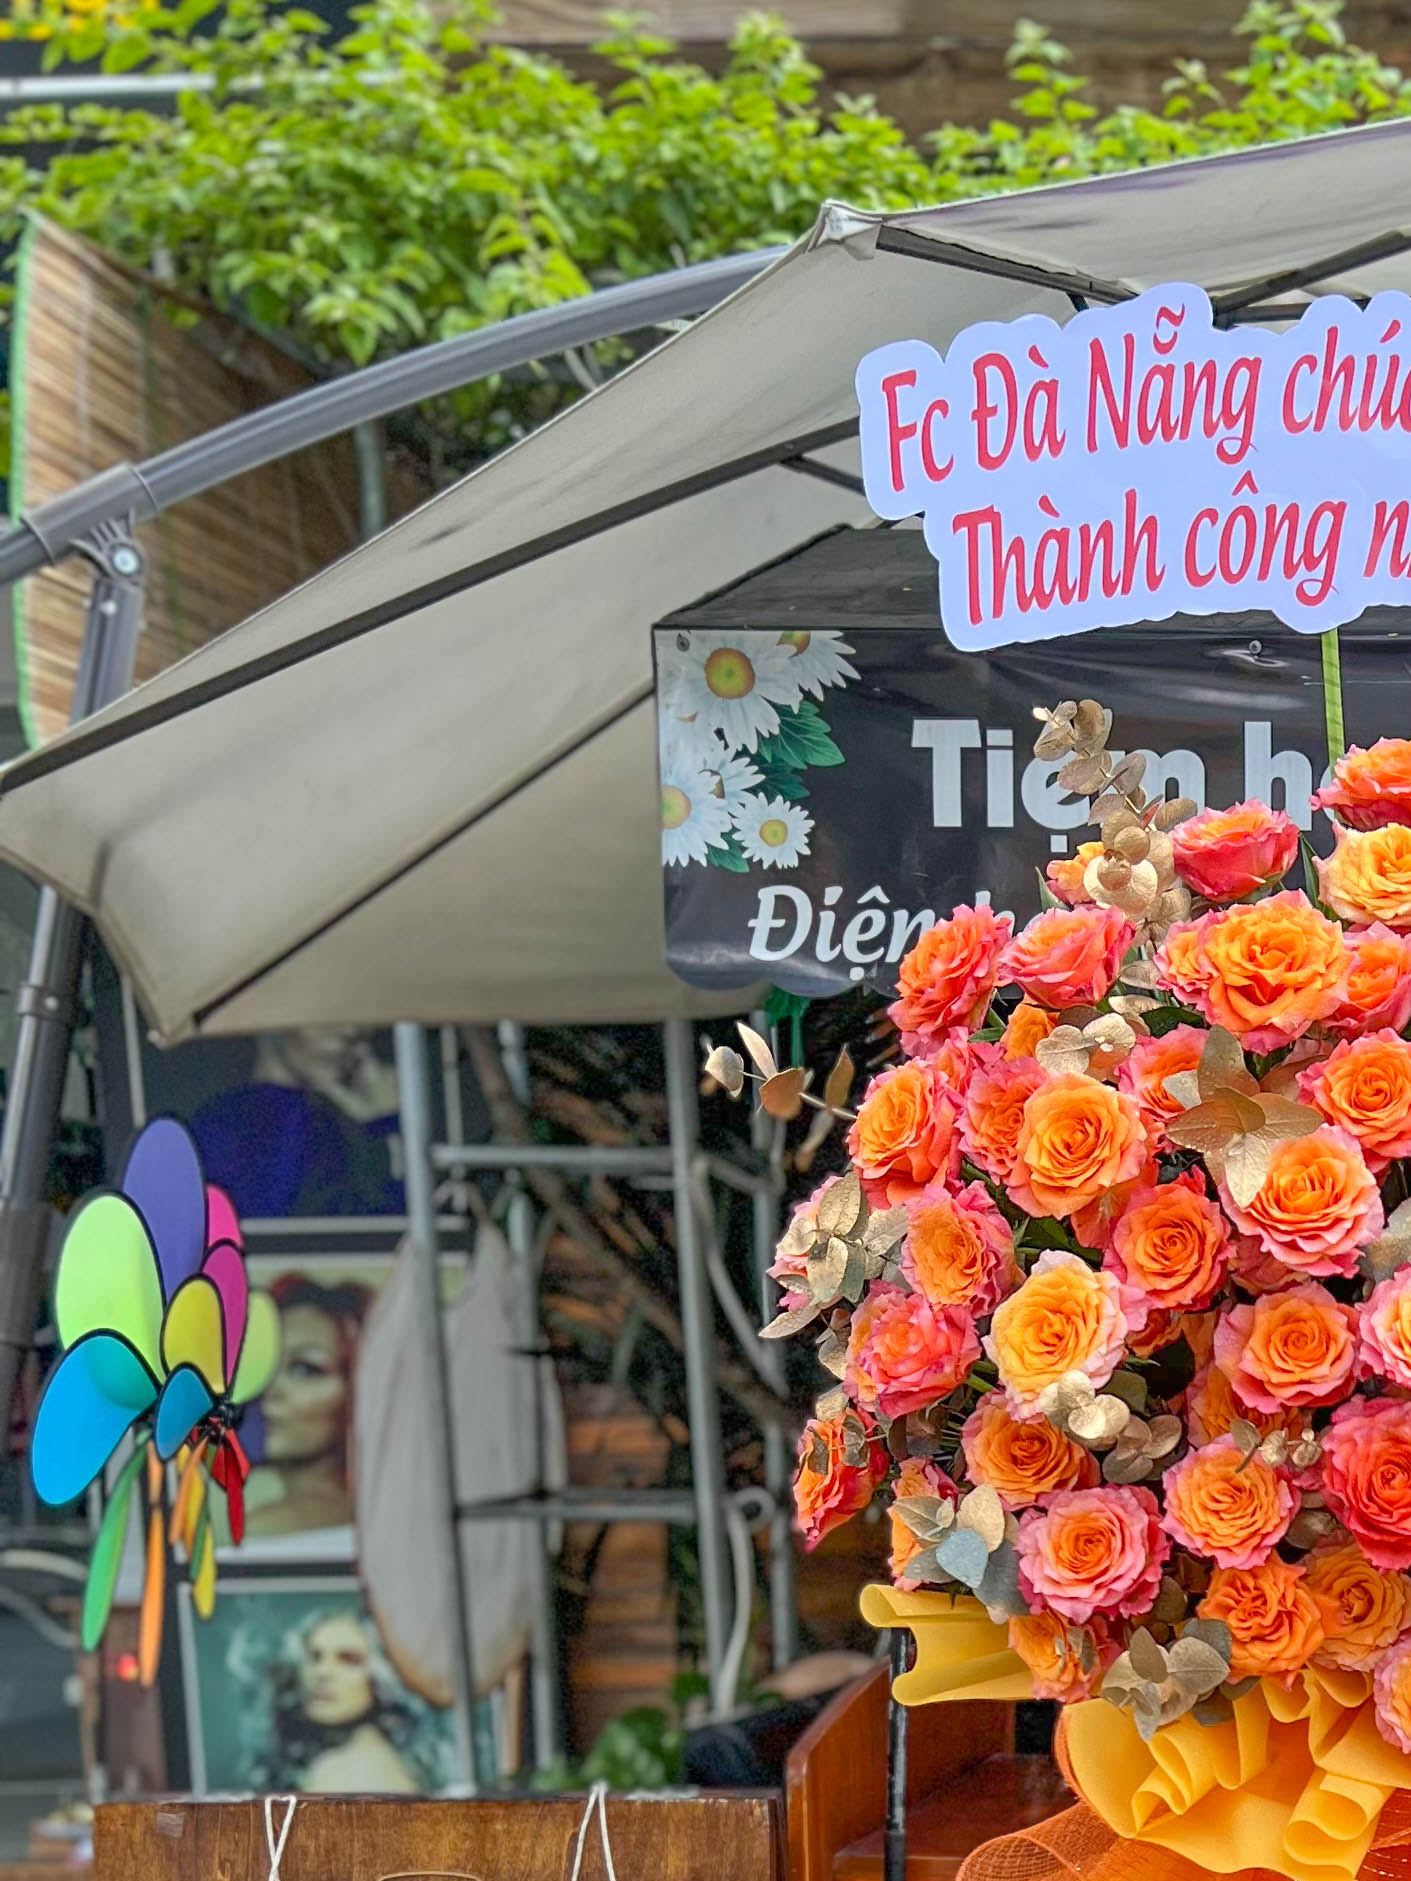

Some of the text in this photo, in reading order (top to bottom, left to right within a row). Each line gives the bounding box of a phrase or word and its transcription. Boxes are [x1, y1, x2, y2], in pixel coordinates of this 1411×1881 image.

[882, 370, 954, 492] Fc
[971, 345, 1066, 471] Đà
[1088, 303, 1262, 465] Nẵng
[953, 488, 1165, 625] Thành
[1185, 470, 1347, 607] công
